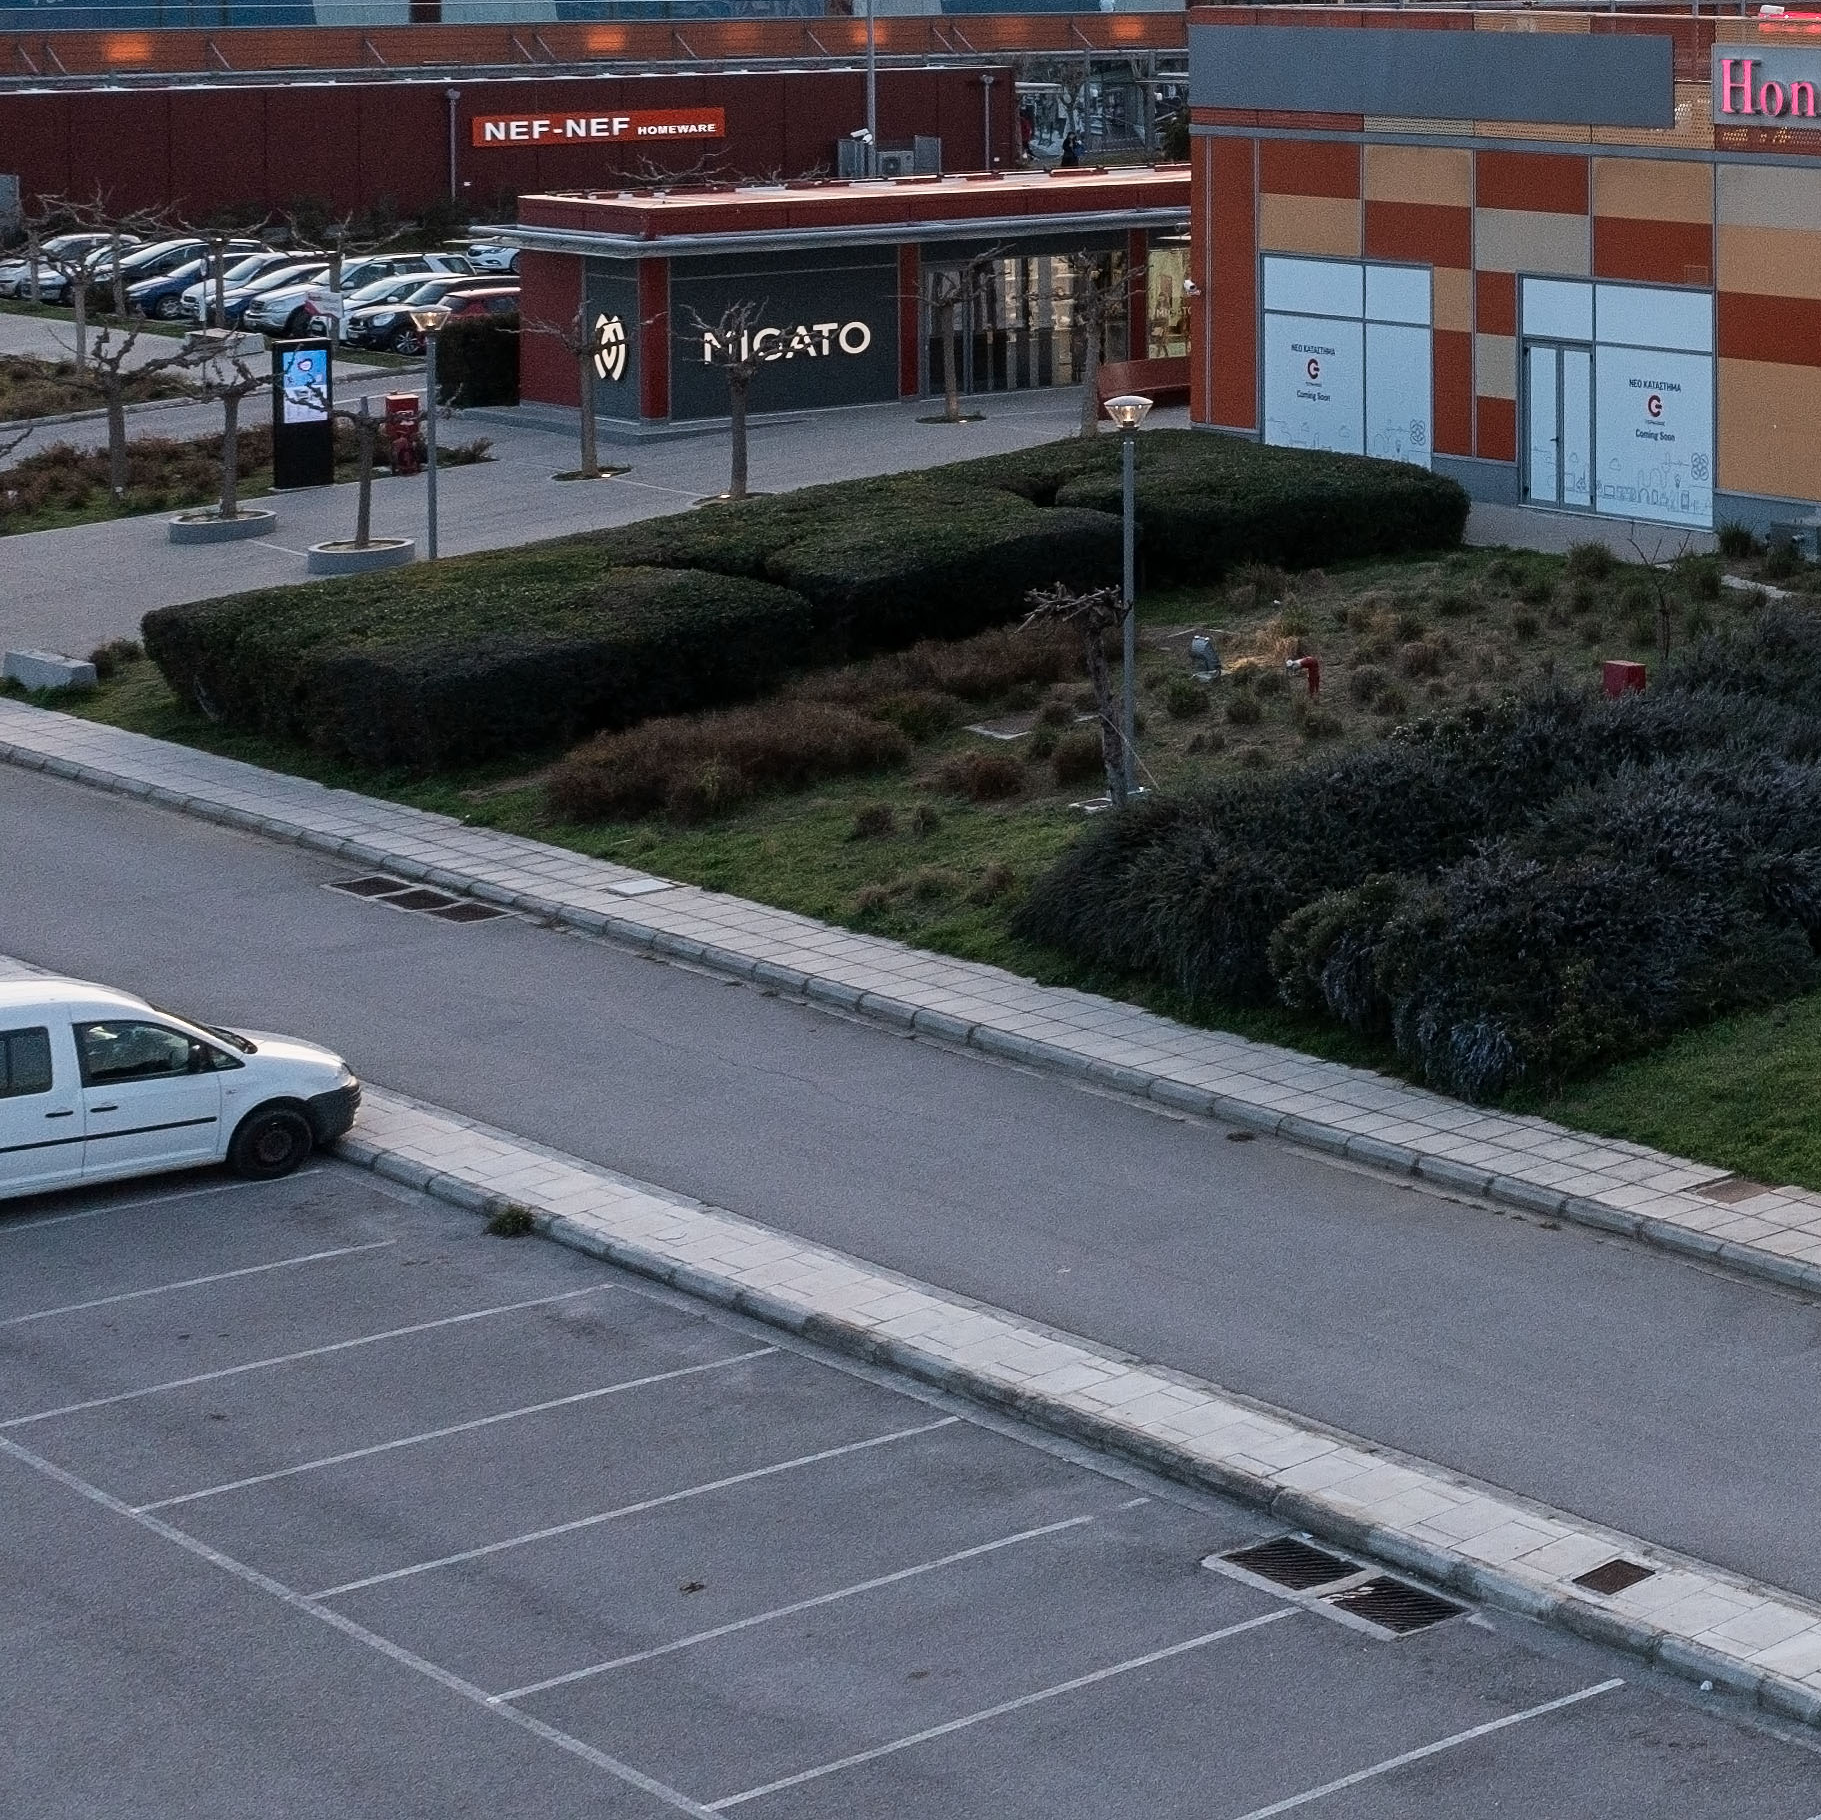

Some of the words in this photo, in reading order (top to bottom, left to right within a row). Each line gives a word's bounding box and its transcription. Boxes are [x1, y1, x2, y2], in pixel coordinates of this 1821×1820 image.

[484, 117, 631, 141] NEF-NEF
[637, 123, 716, 136] HOMEWARE
[1635, 428, 1658, 441] Coming
[1659, 431, 1676, 441] Soon
